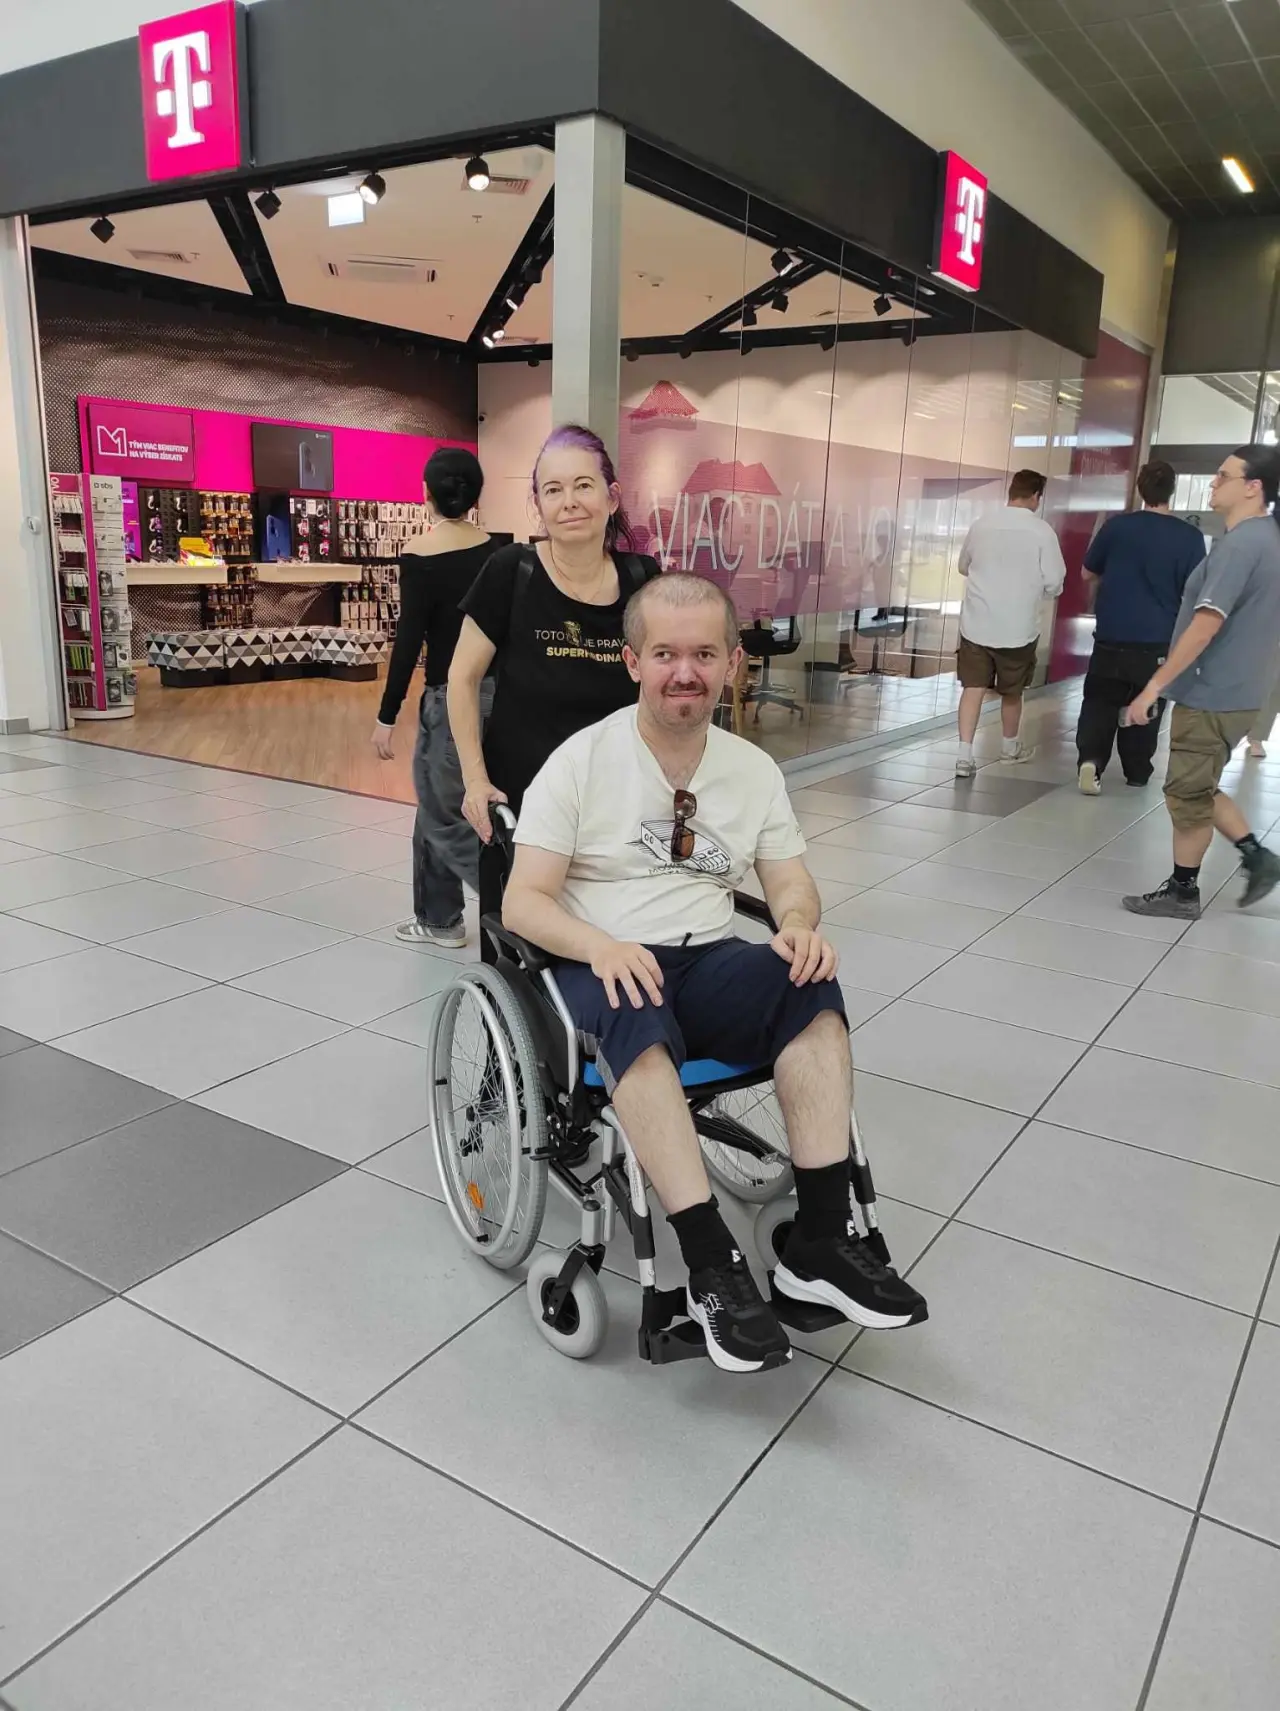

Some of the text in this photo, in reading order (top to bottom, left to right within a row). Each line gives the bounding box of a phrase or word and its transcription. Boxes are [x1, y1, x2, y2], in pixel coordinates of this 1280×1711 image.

[152, 30, 213, 149] T
[954, 176, 985, 266] T
[652, 489, 744, 572] VIAC
[757, 482, 822, 569] DÁT
[825, 503, 847, 567] A
[534, 629, 626, 648] TOTO JE PRAV
